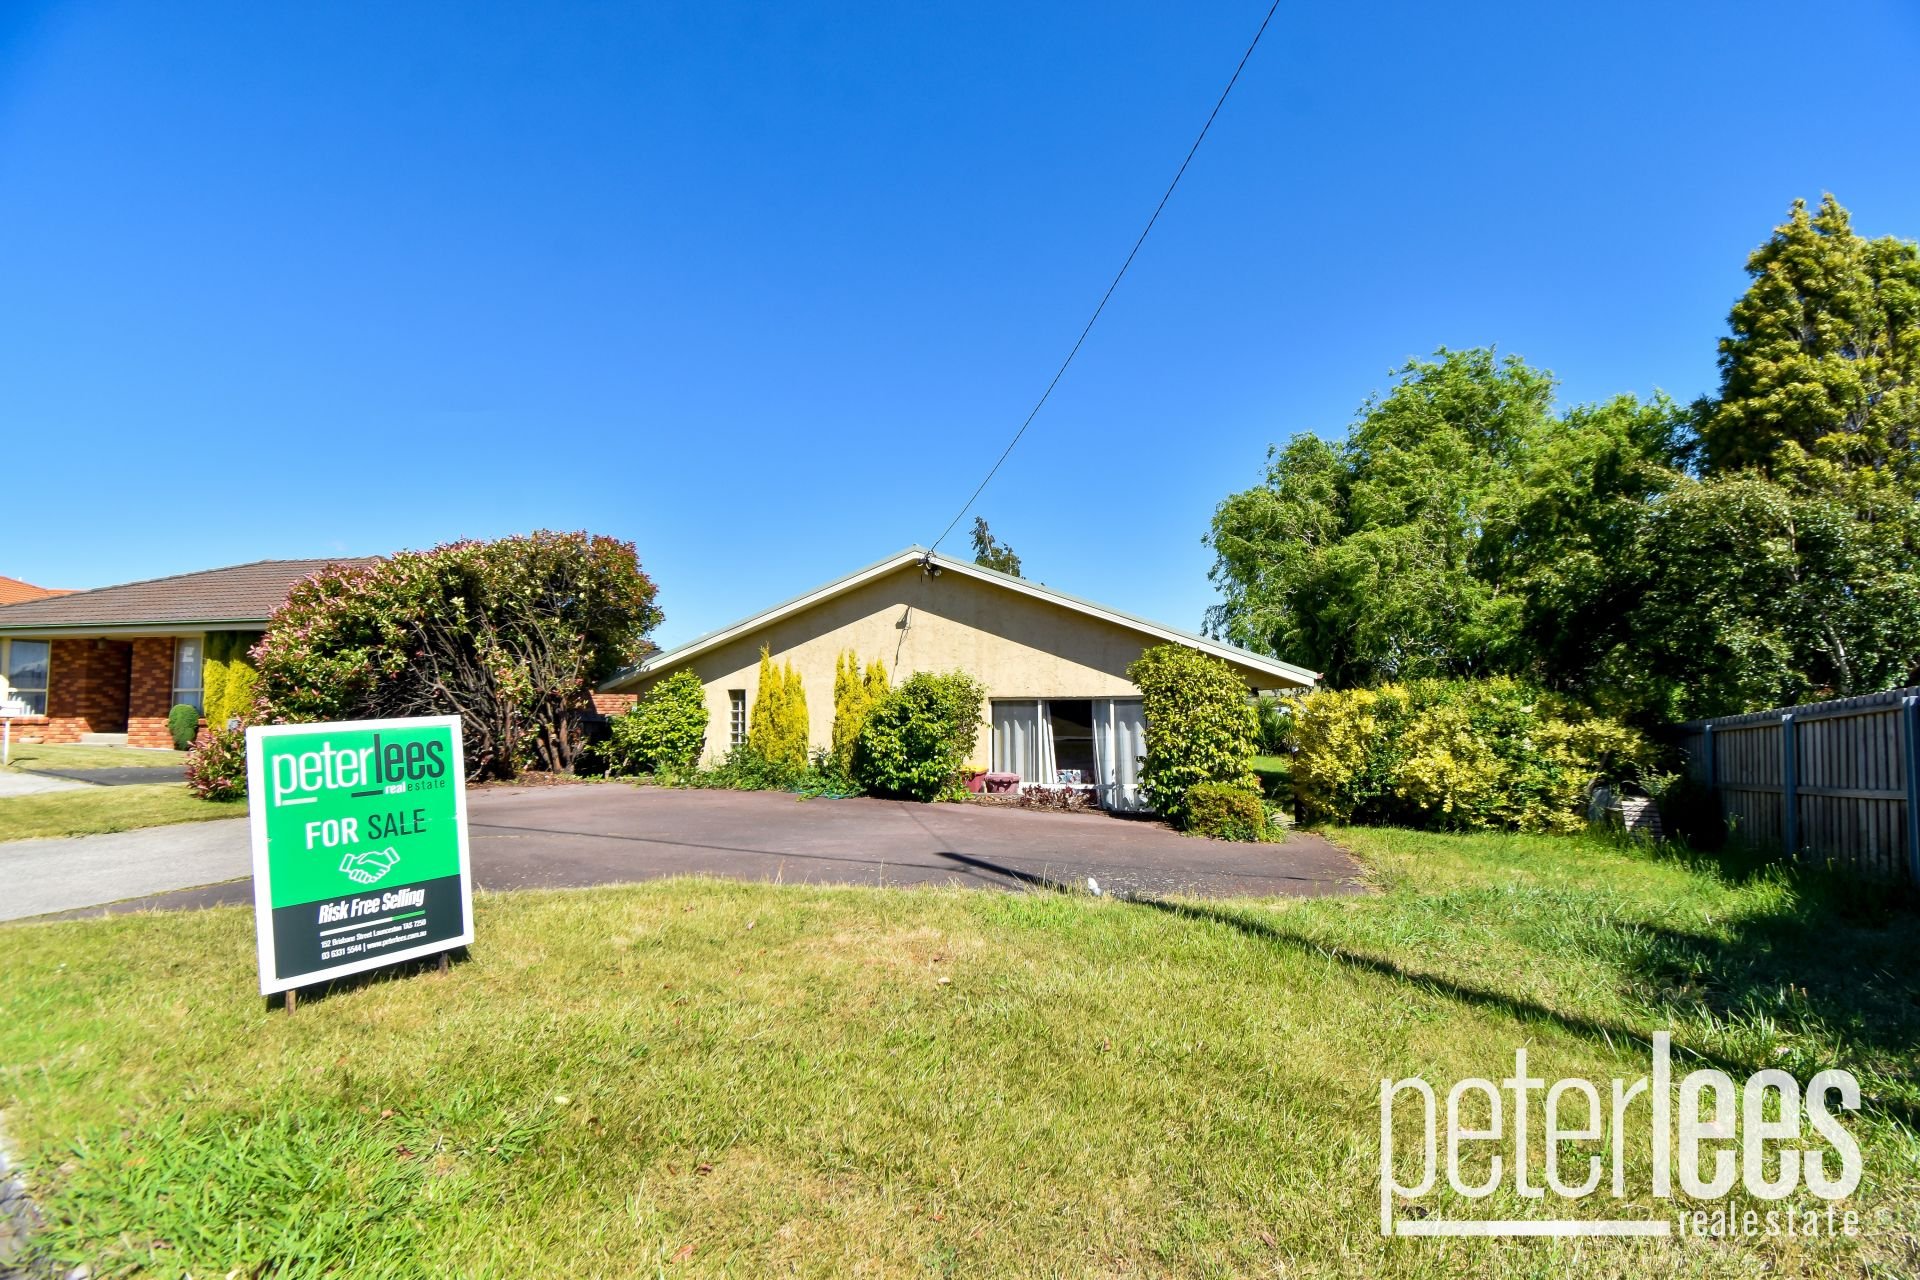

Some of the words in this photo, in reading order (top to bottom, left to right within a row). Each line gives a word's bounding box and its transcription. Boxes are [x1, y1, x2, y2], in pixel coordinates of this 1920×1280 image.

[272, 734, 445, 807] peterlees
[304, 817, 359, 850] FOR
[367, 809, 427, 841] SALE
[318, 900, 350, 924] Risk
[351, 898, 380, 918] Free
[382, 888, 425, 911] Selling
[321, 951, 330, 960] 03
[330, 948, 346, 958] 6331
[346, 943, 362, 954] 5544
[367, 930, 427, 949] www.peterlees.com.au
[332, 935, 356, 946] Brisbane
[356, 931, 372, 941] Street
[402, 921, 413, 930] TAS
[413, 918, 427, 928] 7250
